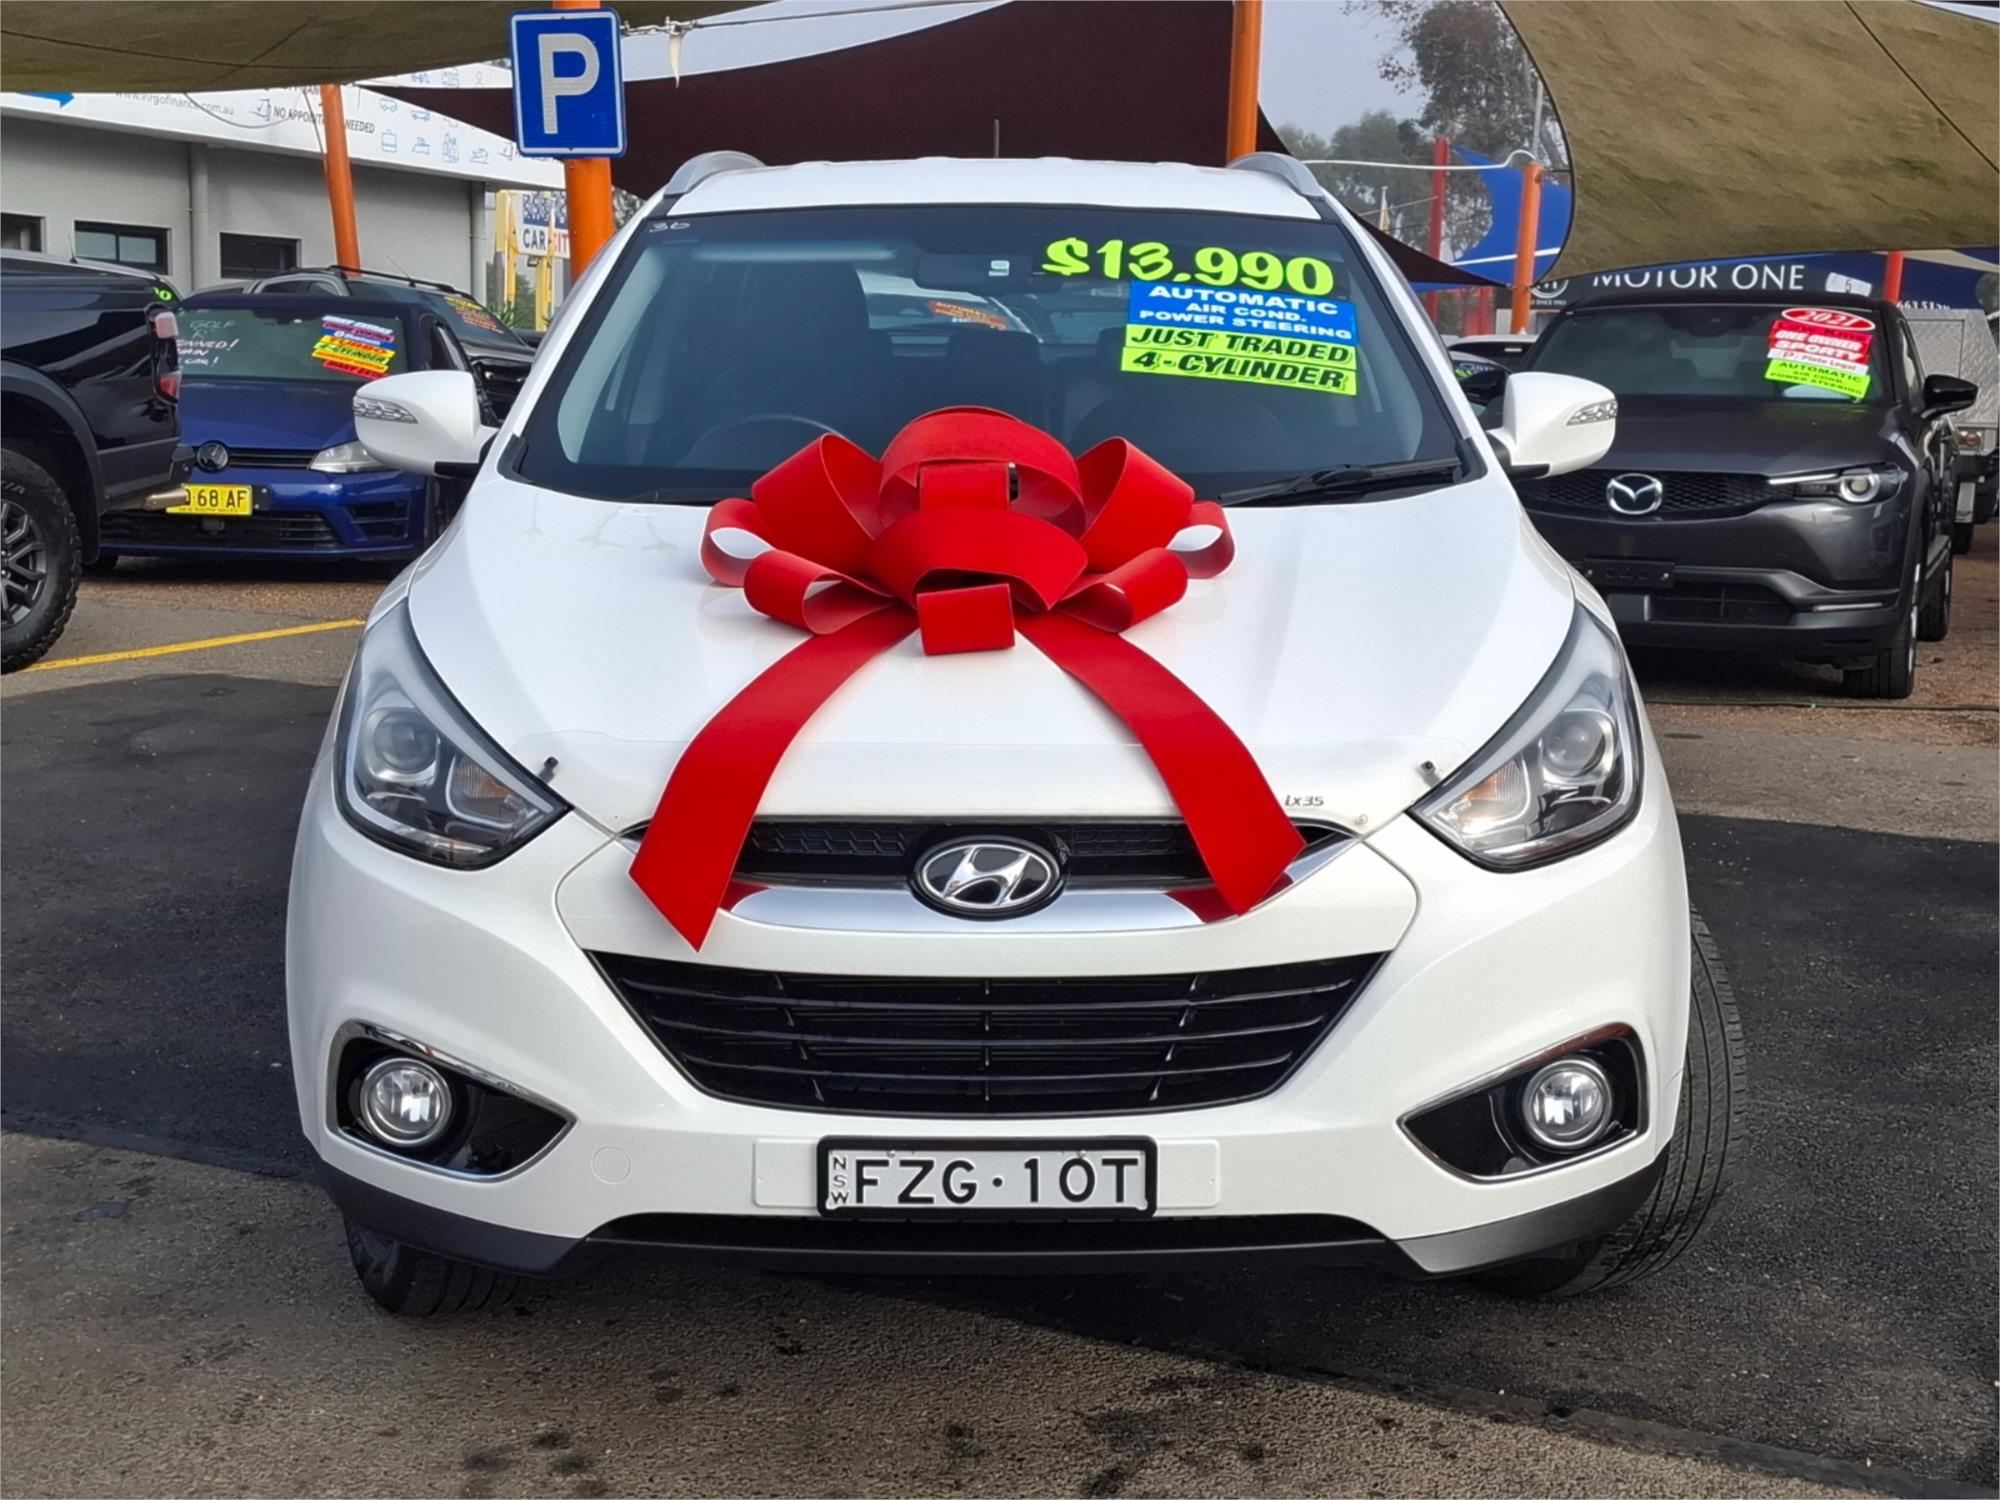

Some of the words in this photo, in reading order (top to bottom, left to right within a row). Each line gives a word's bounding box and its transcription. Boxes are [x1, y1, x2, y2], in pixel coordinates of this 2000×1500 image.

[538, 33, 600, 134] P
[273, 106, 286, 119] NO
[345, 118, 375, 134] NEEDED
[523, 229, 546, 251] CAR
[1731, 263, 1805, 290] ONE
[1149, 285, 1339, 315] AUTOMATIC
[1186, 303, 1227, 315] AIR
[1234, 305, 1307, 323] COND.
[1140, 310, 1225, 326] POWER
[1232, 317, 1353, 340] STEERING
[1795, 310, 1860, 327] 2021
[1131, 328, 1218, 348] JUST
[1226, 333, 1350, 363] TRADED
[1775, 340, 1864, 361] SPORTY
[1132, 351, 1347, 390] 4-CYLINDER
[1779, 362, 1862, 383] AUTOMATIC
[832, 1156, 850, 1205] NSW
